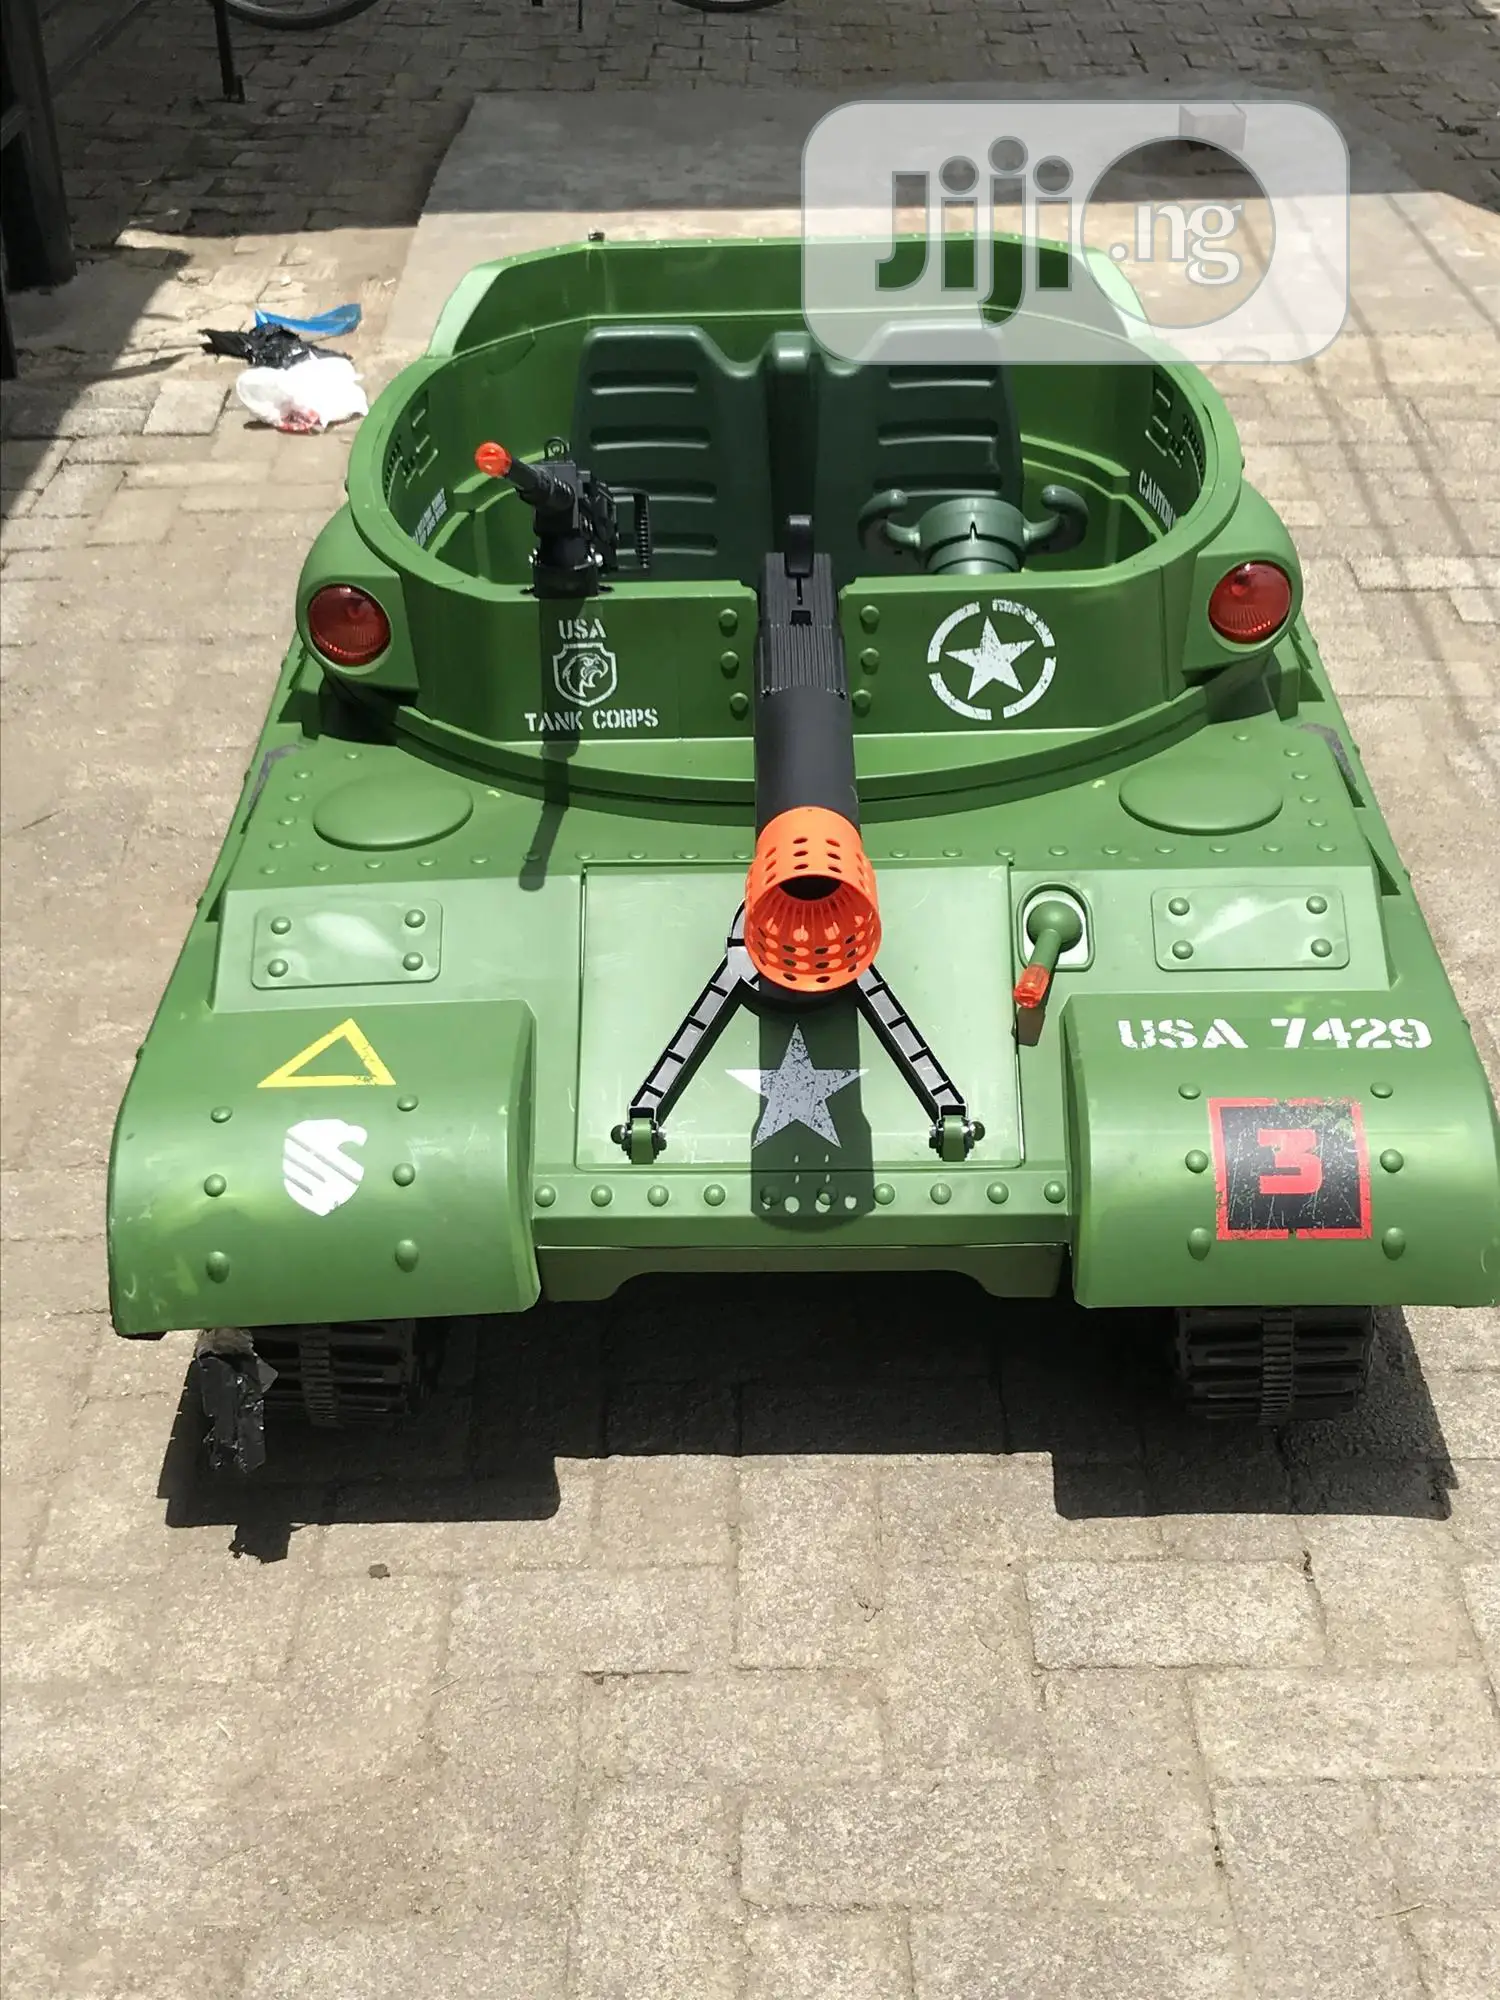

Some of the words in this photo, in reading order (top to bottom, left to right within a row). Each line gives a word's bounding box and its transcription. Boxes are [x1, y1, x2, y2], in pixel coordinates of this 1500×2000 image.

[558, 618, 607, 640] USA
[524, 710, 584, 733] TANK
[592, 707, 659, 730] CORPS
[1117, 1018, 1249, 1050] USA
[1270, 1017, 1433, 1050] 7429
[1257, 1128, 1323, 1195] 3
